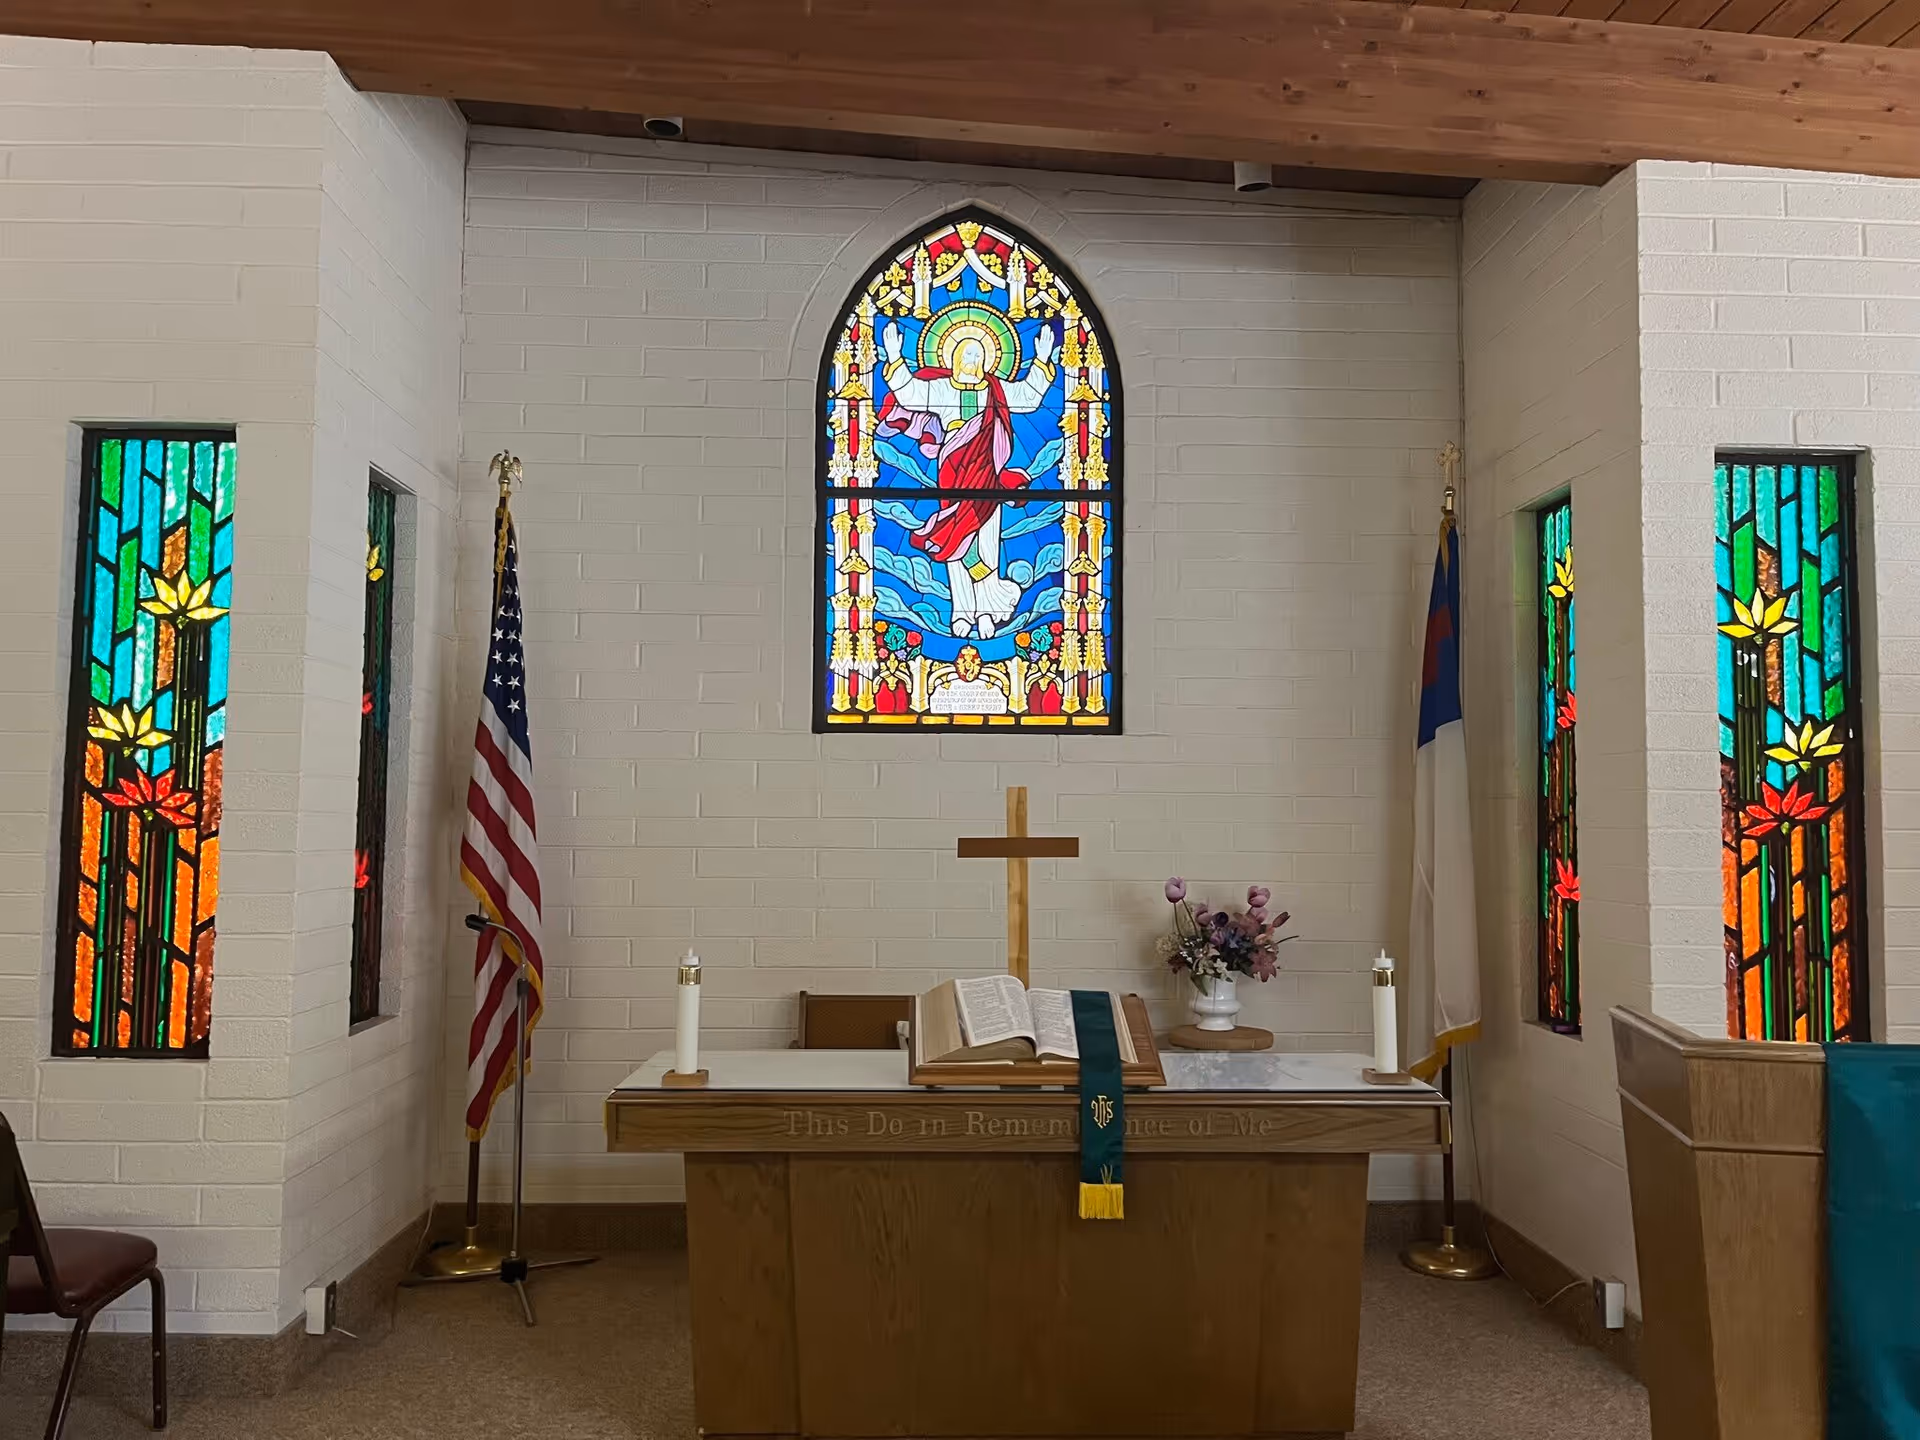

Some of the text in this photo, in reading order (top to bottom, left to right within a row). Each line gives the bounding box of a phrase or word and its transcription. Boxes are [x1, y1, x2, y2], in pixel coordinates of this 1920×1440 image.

[784, 1111, 1273, 1136] This Do in Rememnce of Me
